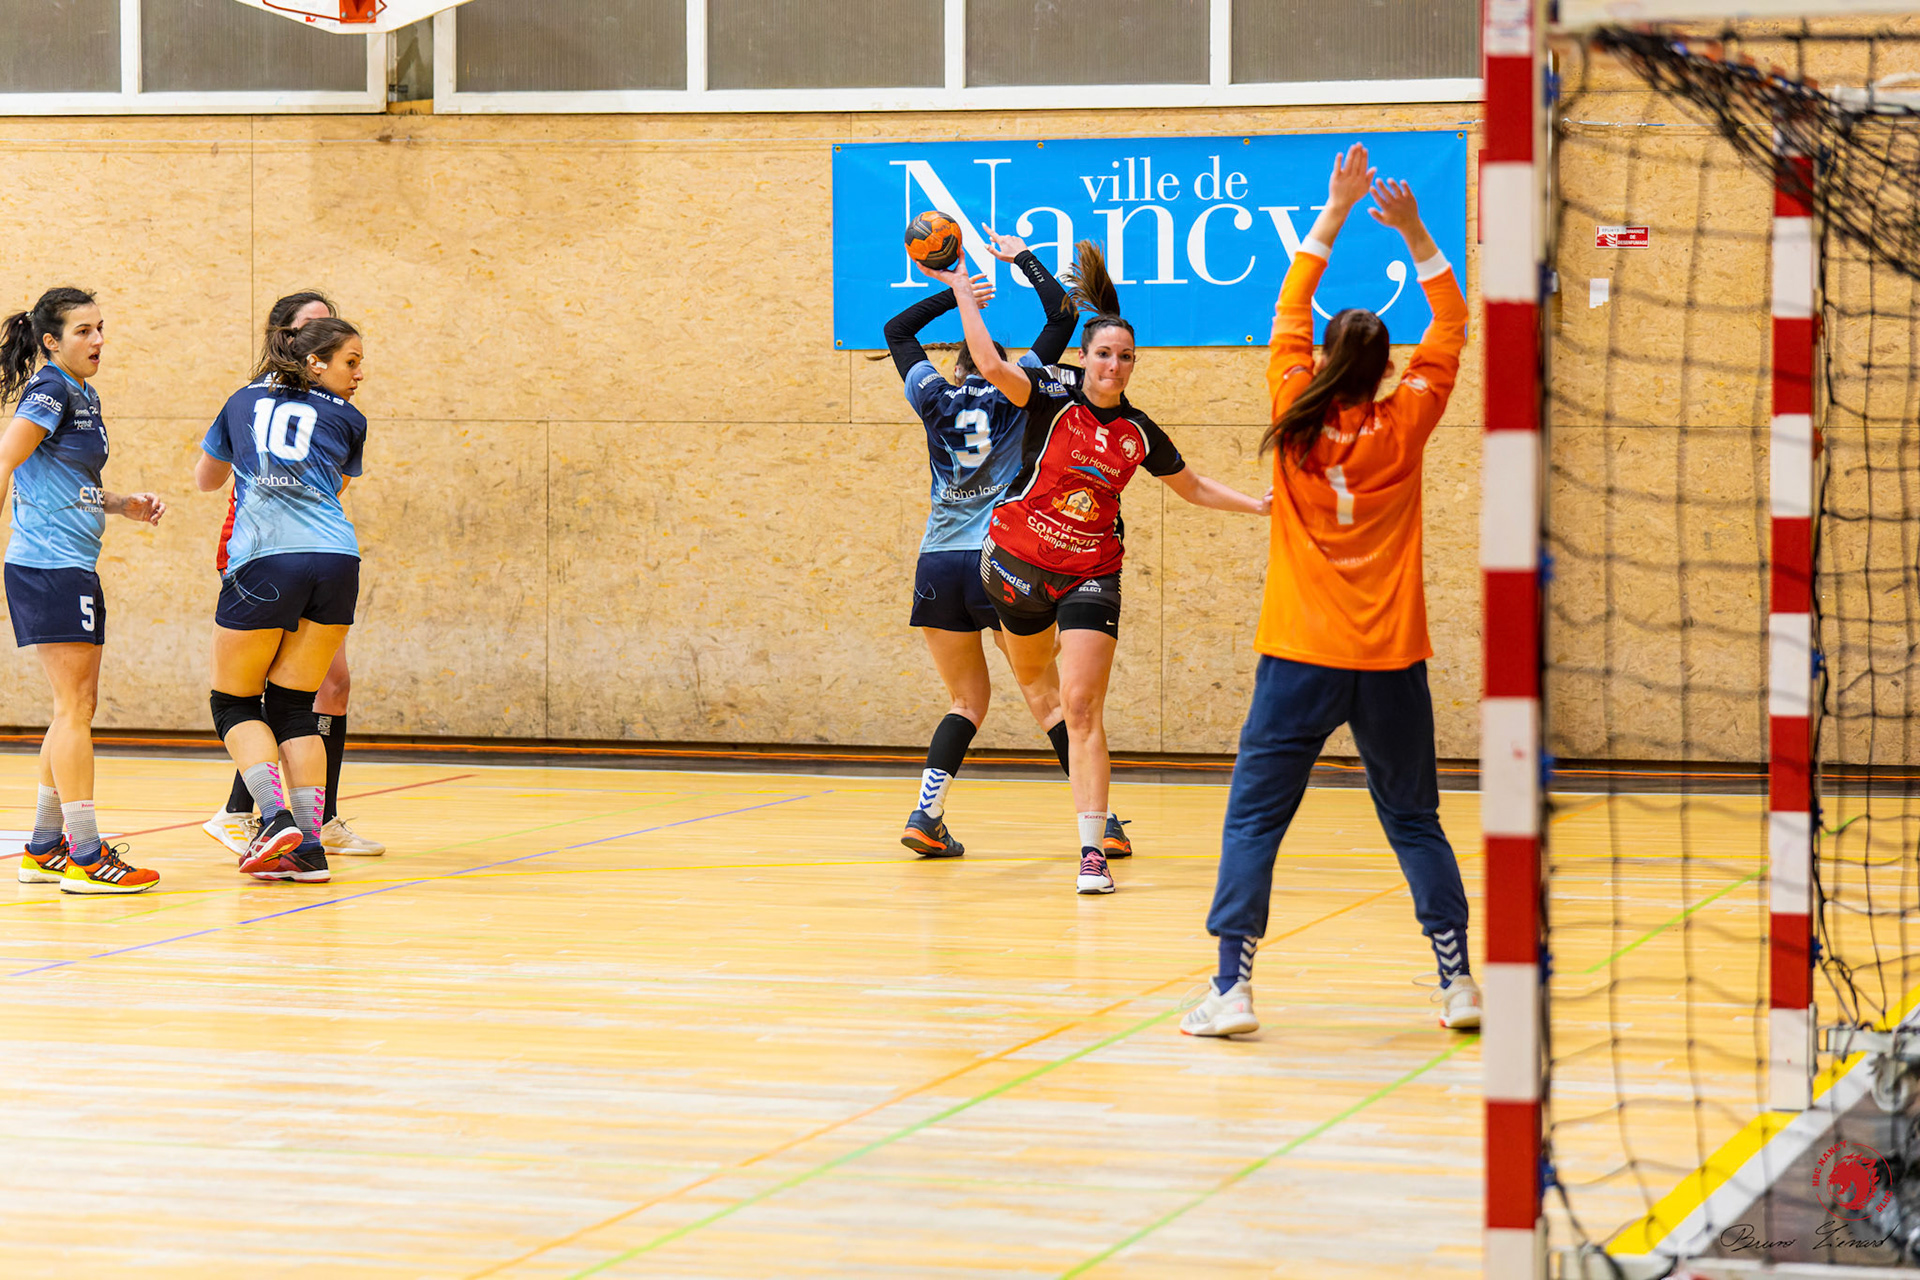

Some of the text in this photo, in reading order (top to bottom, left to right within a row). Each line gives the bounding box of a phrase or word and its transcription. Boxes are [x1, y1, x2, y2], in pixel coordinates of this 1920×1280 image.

[1080, 155, 1248, 202] ville de
[253, 397, 318, 462] 10
[955, 408, 993, 469] 3
[1094, 426, 1109, 453] 5
[1071, 449, 1088, 464] Guy
[1089, 457, 1121, 478] Hoquet
[940, 487, 976, 502] alpha
[1325, 465, 1355, 525] 1
[1038, 530, 1082, 553] Campanile
[1061, 523, 1073, 533] LE
[79, 595, 95, 632] 5
